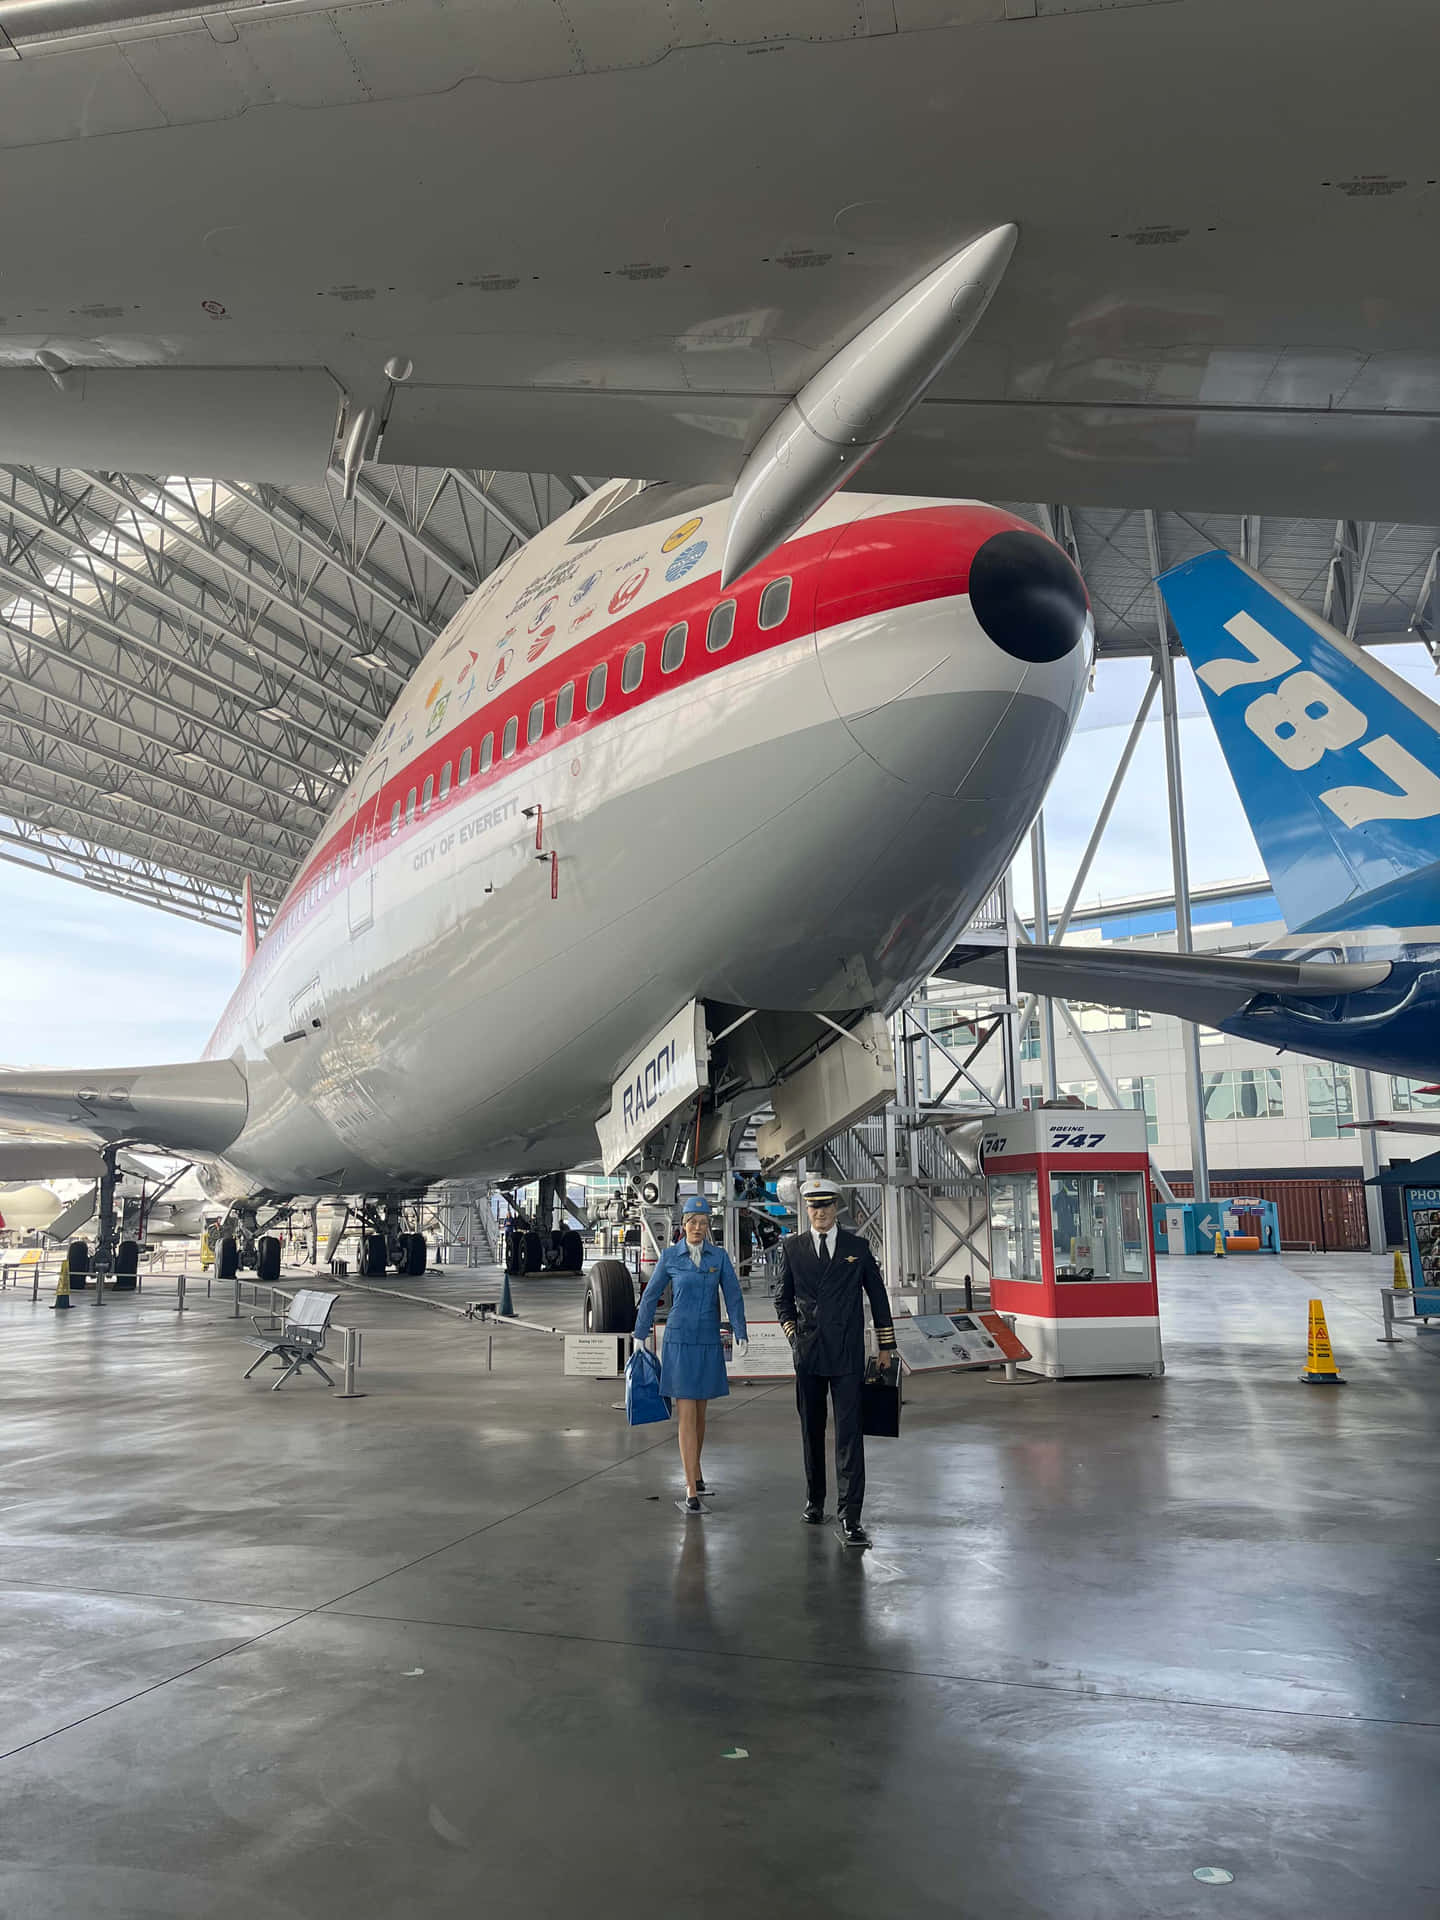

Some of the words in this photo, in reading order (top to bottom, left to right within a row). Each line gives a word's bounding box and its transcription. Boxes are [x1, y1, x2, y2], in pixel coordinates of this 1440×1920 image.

[1195, 610, 1440, 830] 787
[413, 843, 436, 871] CITY
[439, 833, 455, 855] OF
[459, 796, 519, 844] EVERETT
[985, 1138, 1007, 1153] 747
[1051, 1133, 1106, 1148] 747
